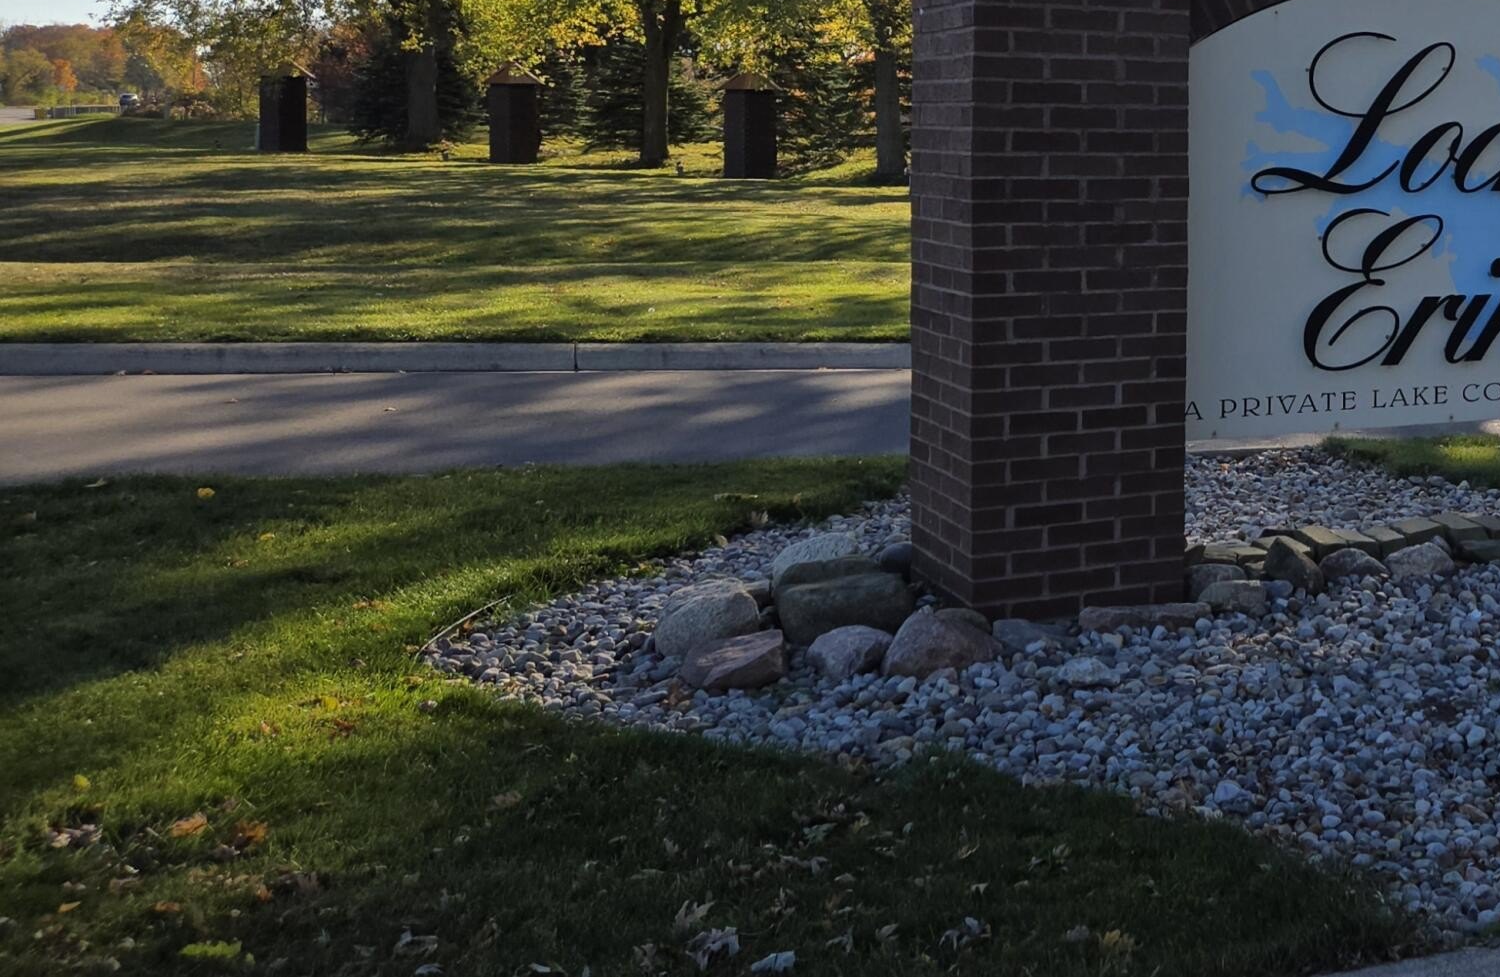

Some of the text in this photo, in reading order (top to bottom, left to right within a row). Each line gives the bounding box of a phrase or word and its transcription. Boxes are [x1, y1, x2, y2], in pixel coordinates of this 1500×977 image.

[1185, 400, 1203, 421] A
[1219, 390, 1357, 419] PRIVATE
[1371, 386, 1448, 409] LAKE
